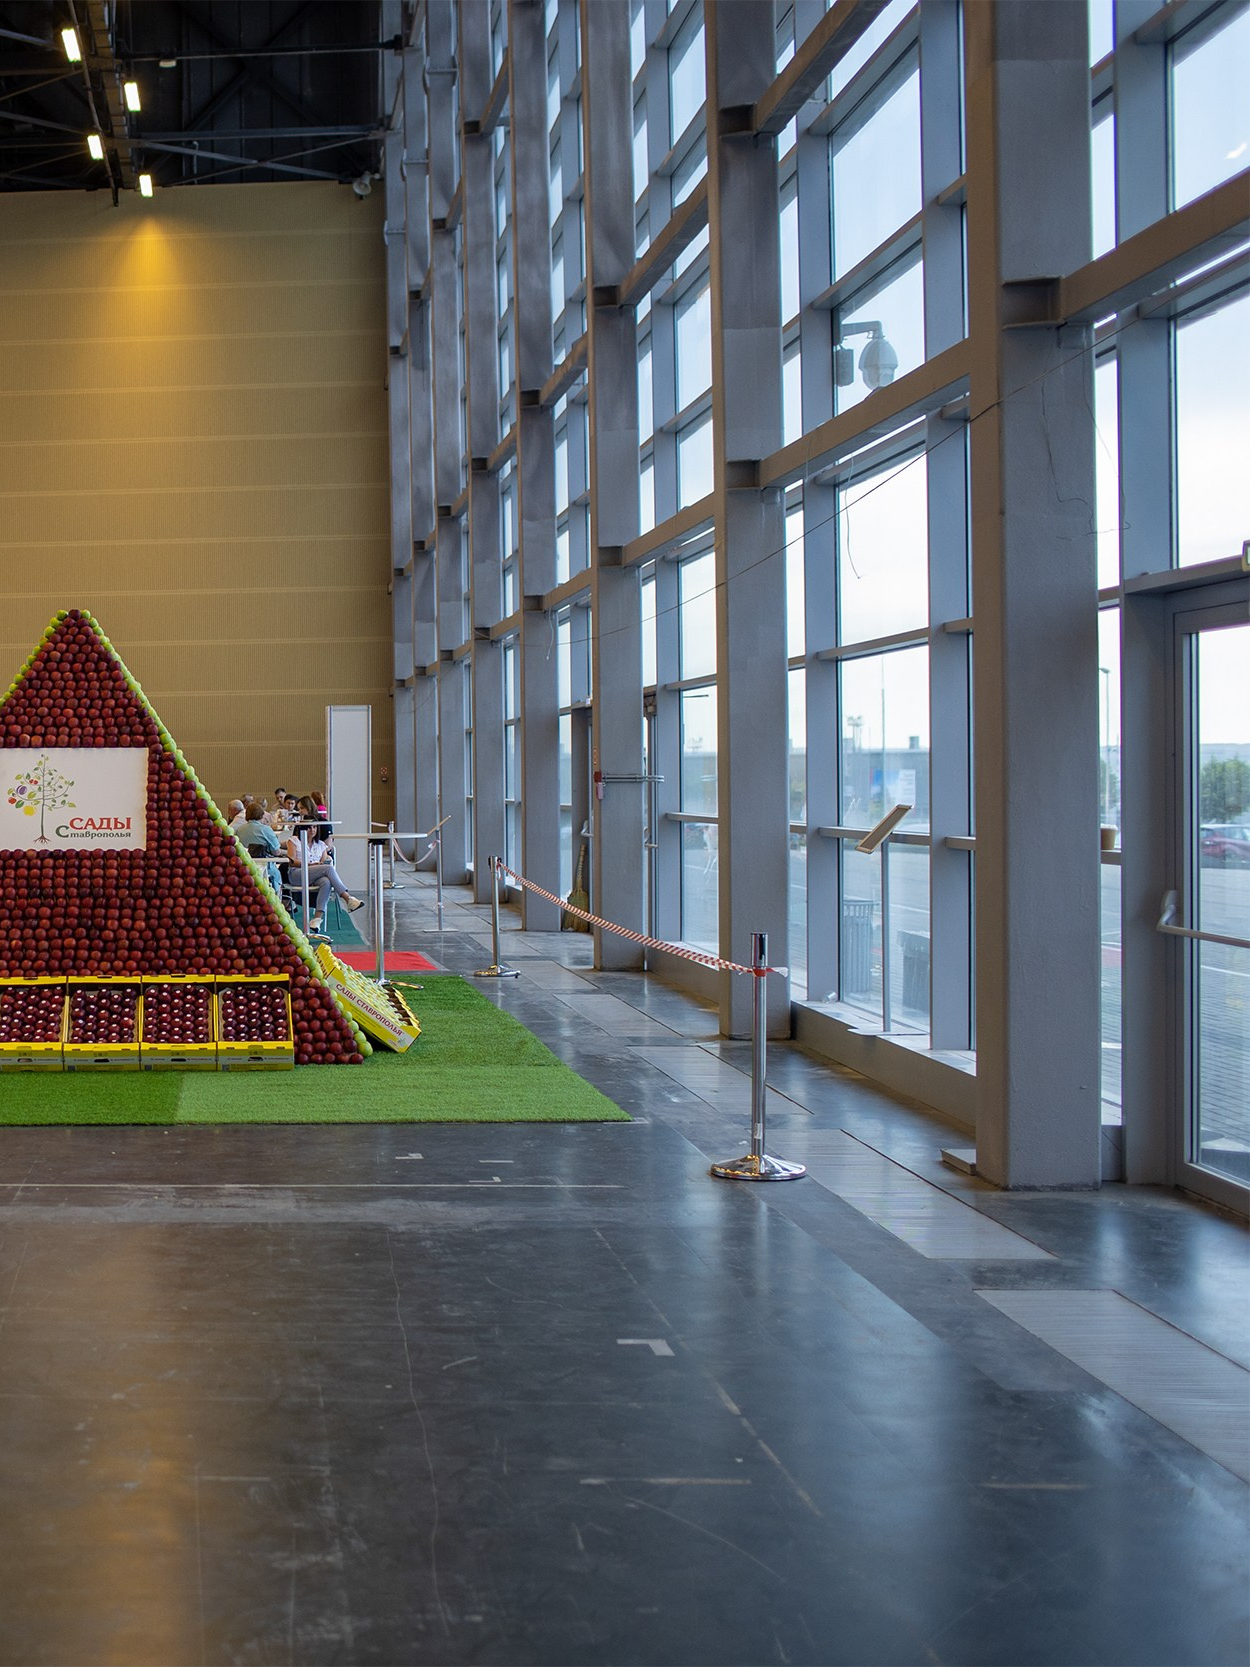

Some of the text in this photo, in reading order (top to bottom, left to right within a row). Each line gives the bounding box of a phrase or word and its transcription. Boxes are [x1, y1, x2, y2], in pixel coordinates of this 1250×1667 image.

[69, 817, 132, 831] САДЫ
[55, 825, 132, 839] Ставрополья
[335, 983, 356, 1001] САДЫ
[356, 998, 403, 1036] СТАВРОПОЛЬЯ
